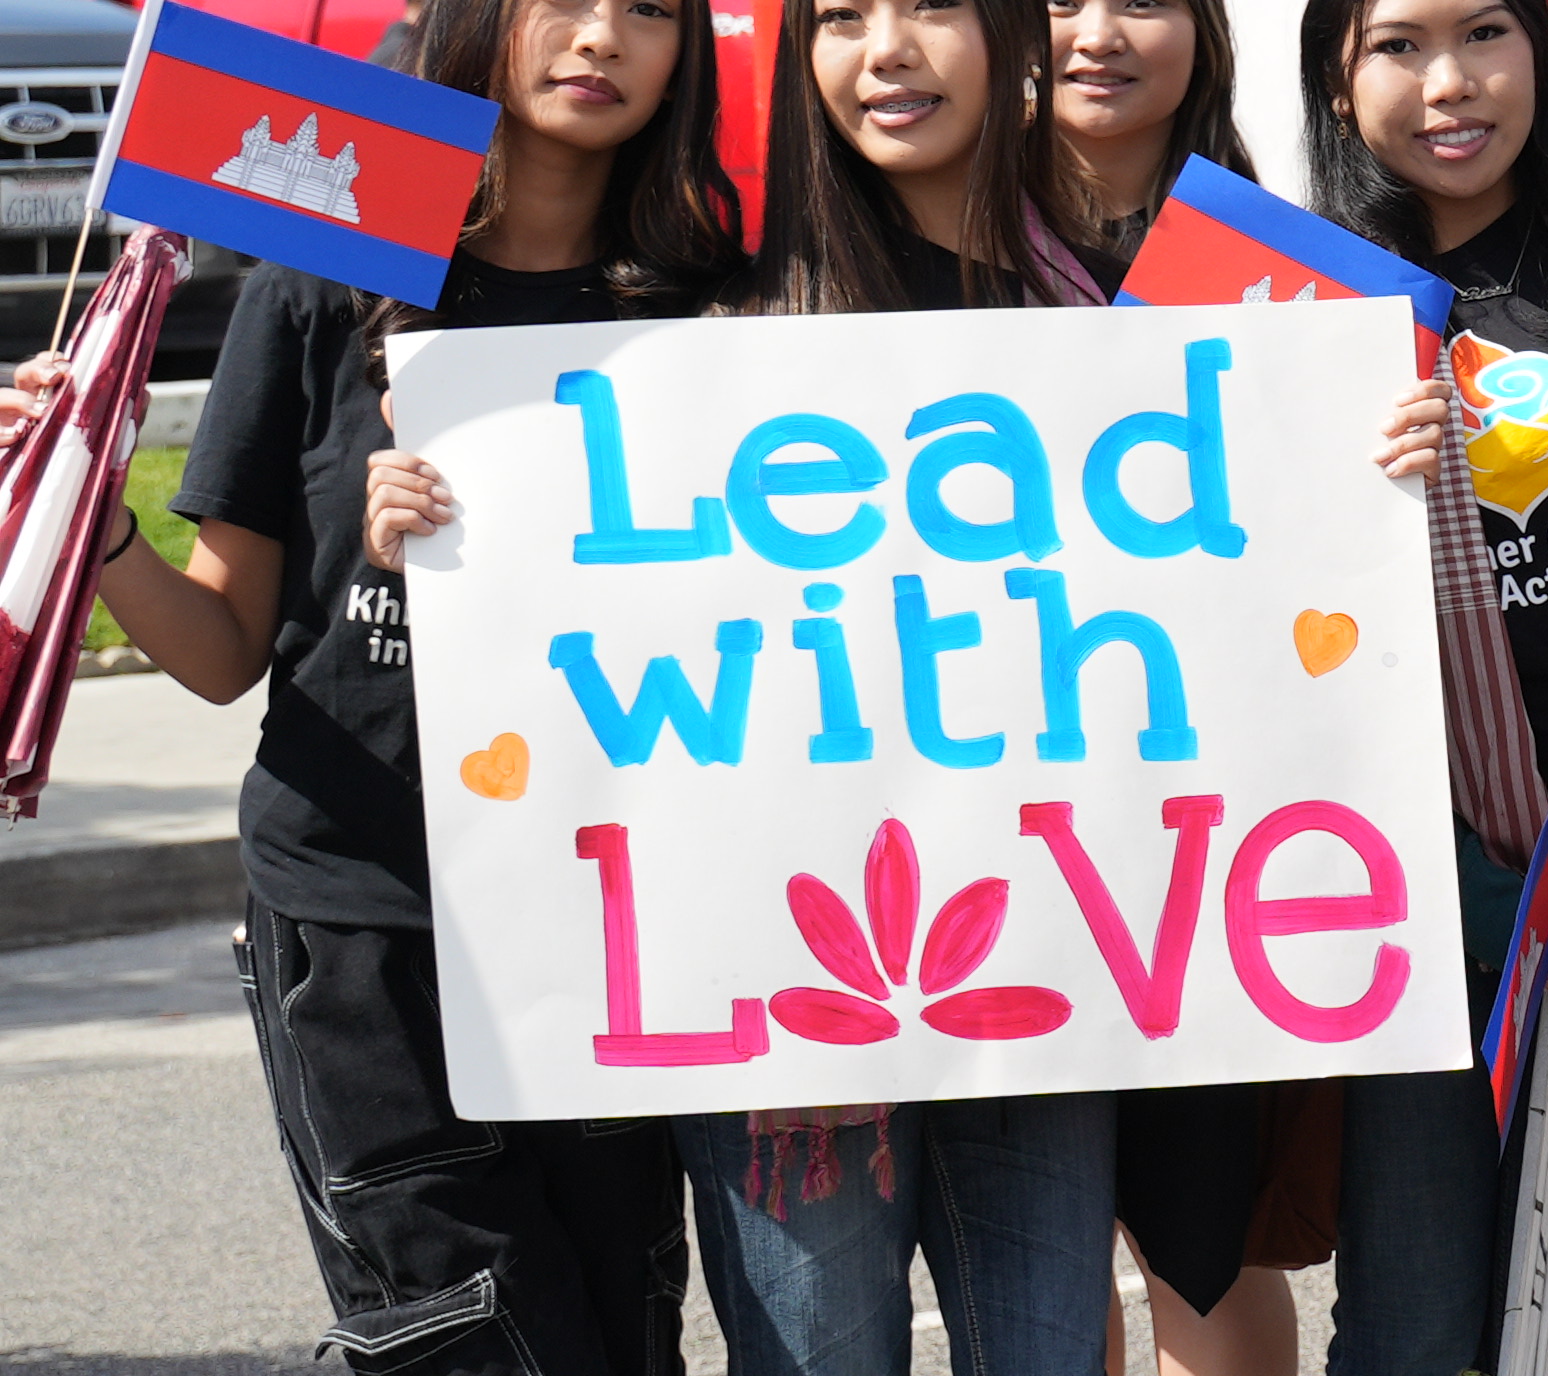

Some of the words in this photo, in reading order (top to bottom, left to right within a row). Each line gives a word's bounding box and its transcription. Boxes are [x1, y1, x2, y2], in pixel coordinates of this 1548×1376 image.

[554, 337, 1249, 571] Lead
[346, 584, 410, 627] Kh
[368, 628, 408, 666] in
[548, 568, 1199, 768] with
